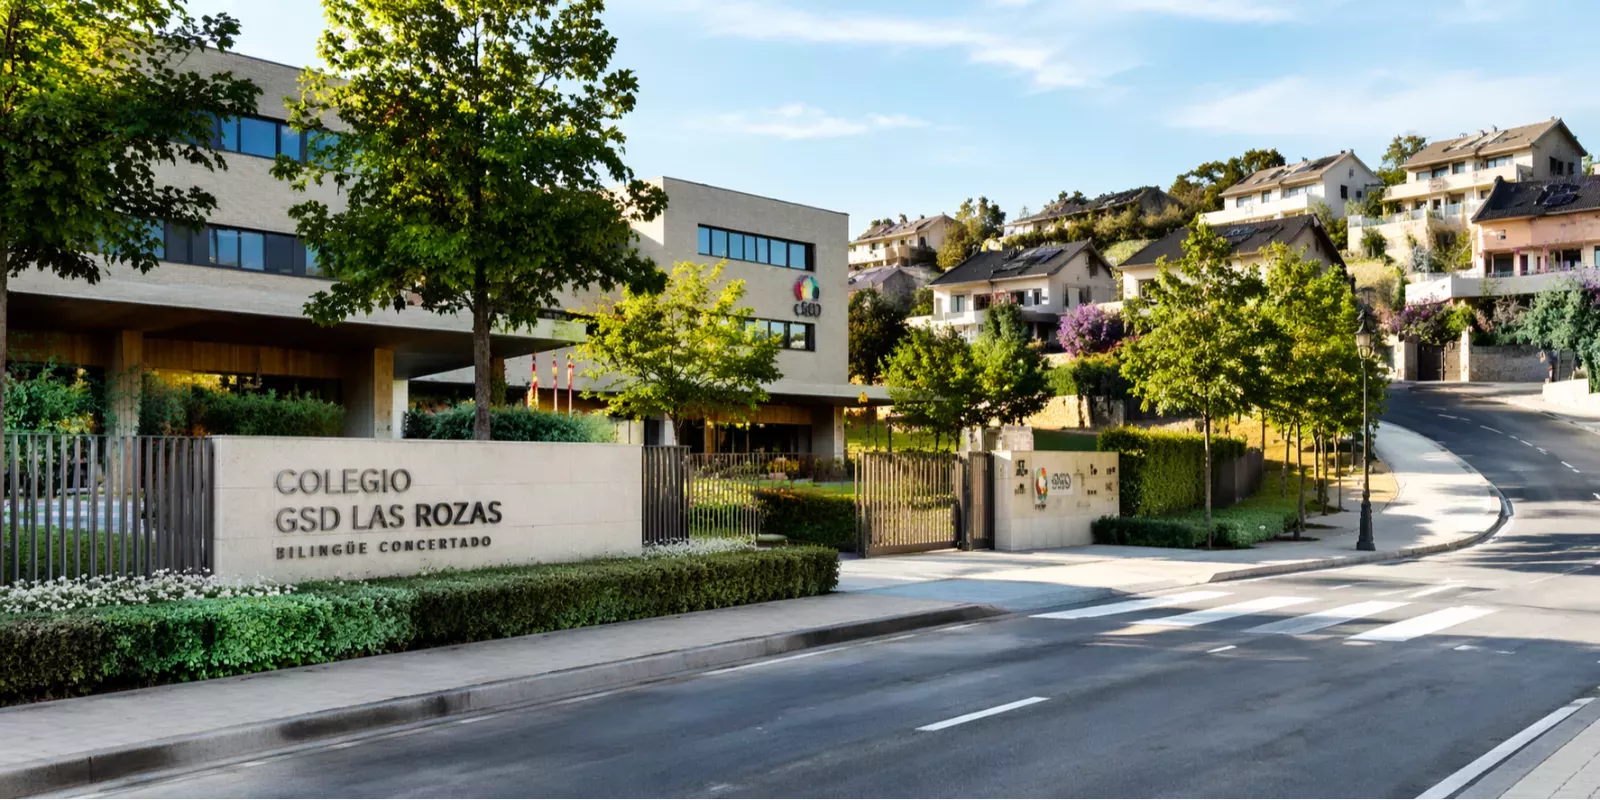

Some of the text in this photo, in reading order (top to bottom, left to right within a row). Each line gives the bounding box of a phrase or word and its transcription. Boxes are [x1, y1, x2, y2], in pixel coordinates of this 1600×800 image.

[276, 468, 412, 495] COLEGIO
[276, 500, 503, 533] GSD LAS ROZAS
[276, 535, 492, 560] BILINGÜE CONCERTADO
